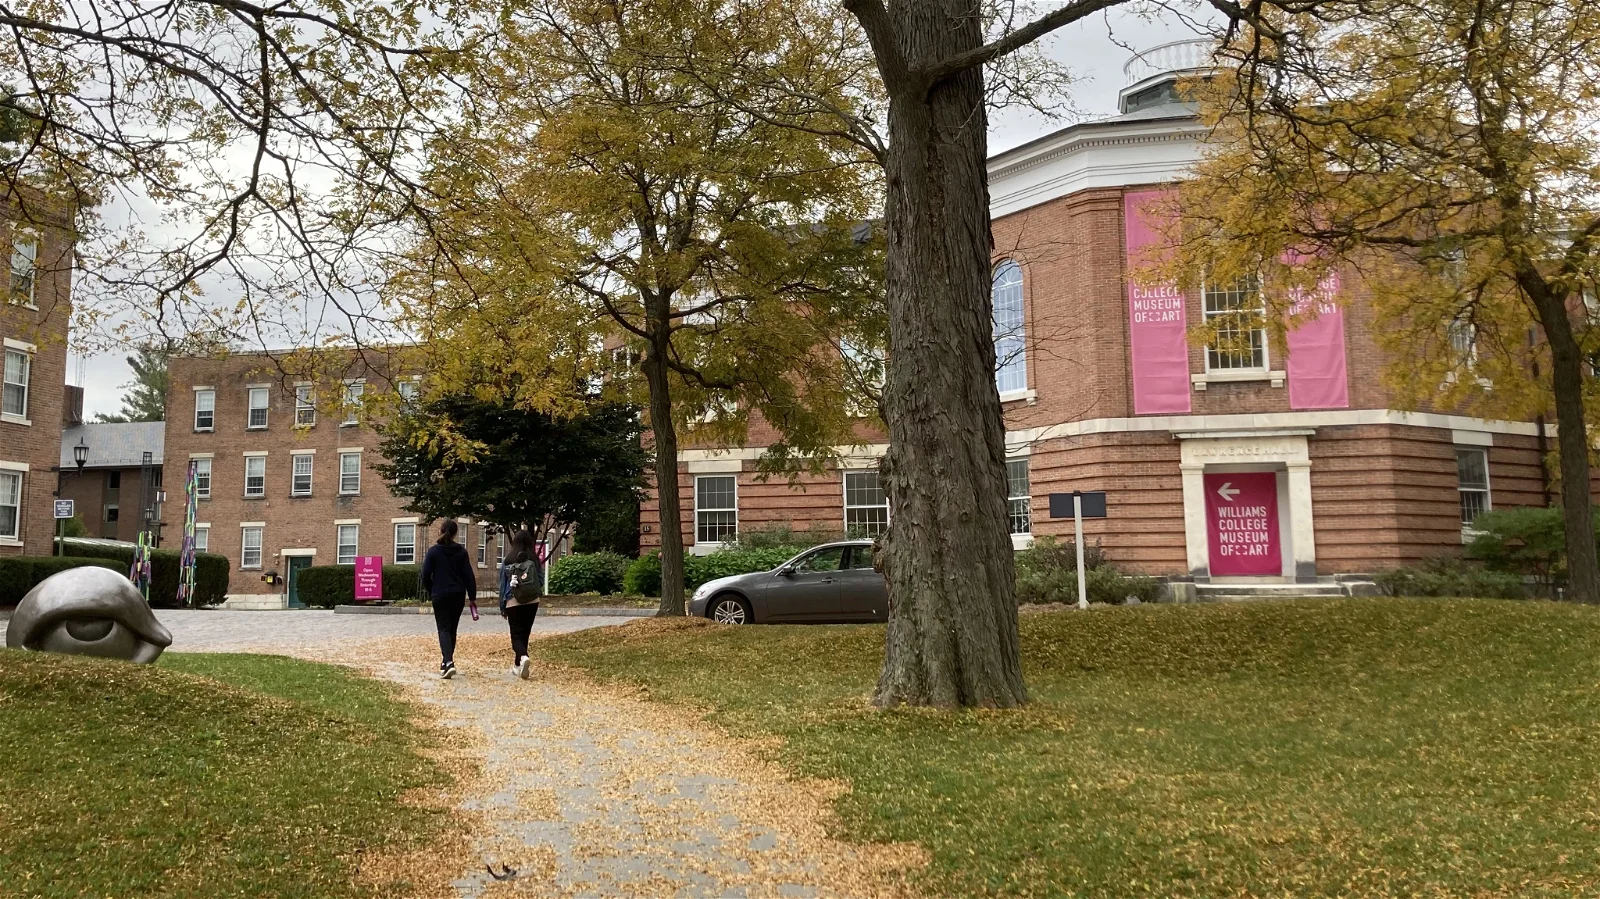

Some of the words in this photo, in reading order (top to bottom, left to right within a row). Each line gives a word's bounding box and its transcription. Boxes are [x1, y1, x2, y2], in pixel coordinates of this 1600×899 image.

[1134, 299, 1181, 310] MUSEUM
[1135, 312, 1148, 322] OF
[1162, 311, 1181, 321] ART
[1192, 446, 1260, 457] LAWRENCE
[1262, 444, 1299, 455] HALL
[1218, 506, 1267, 518] WILLIAMS
[1219, 519, 1268, 530] COLLEGE
[1220, 532, 1269, 543] MUSEUM
[1220, 545, 1234, 556] OF
[1249, 544, 1269, 555] ART
